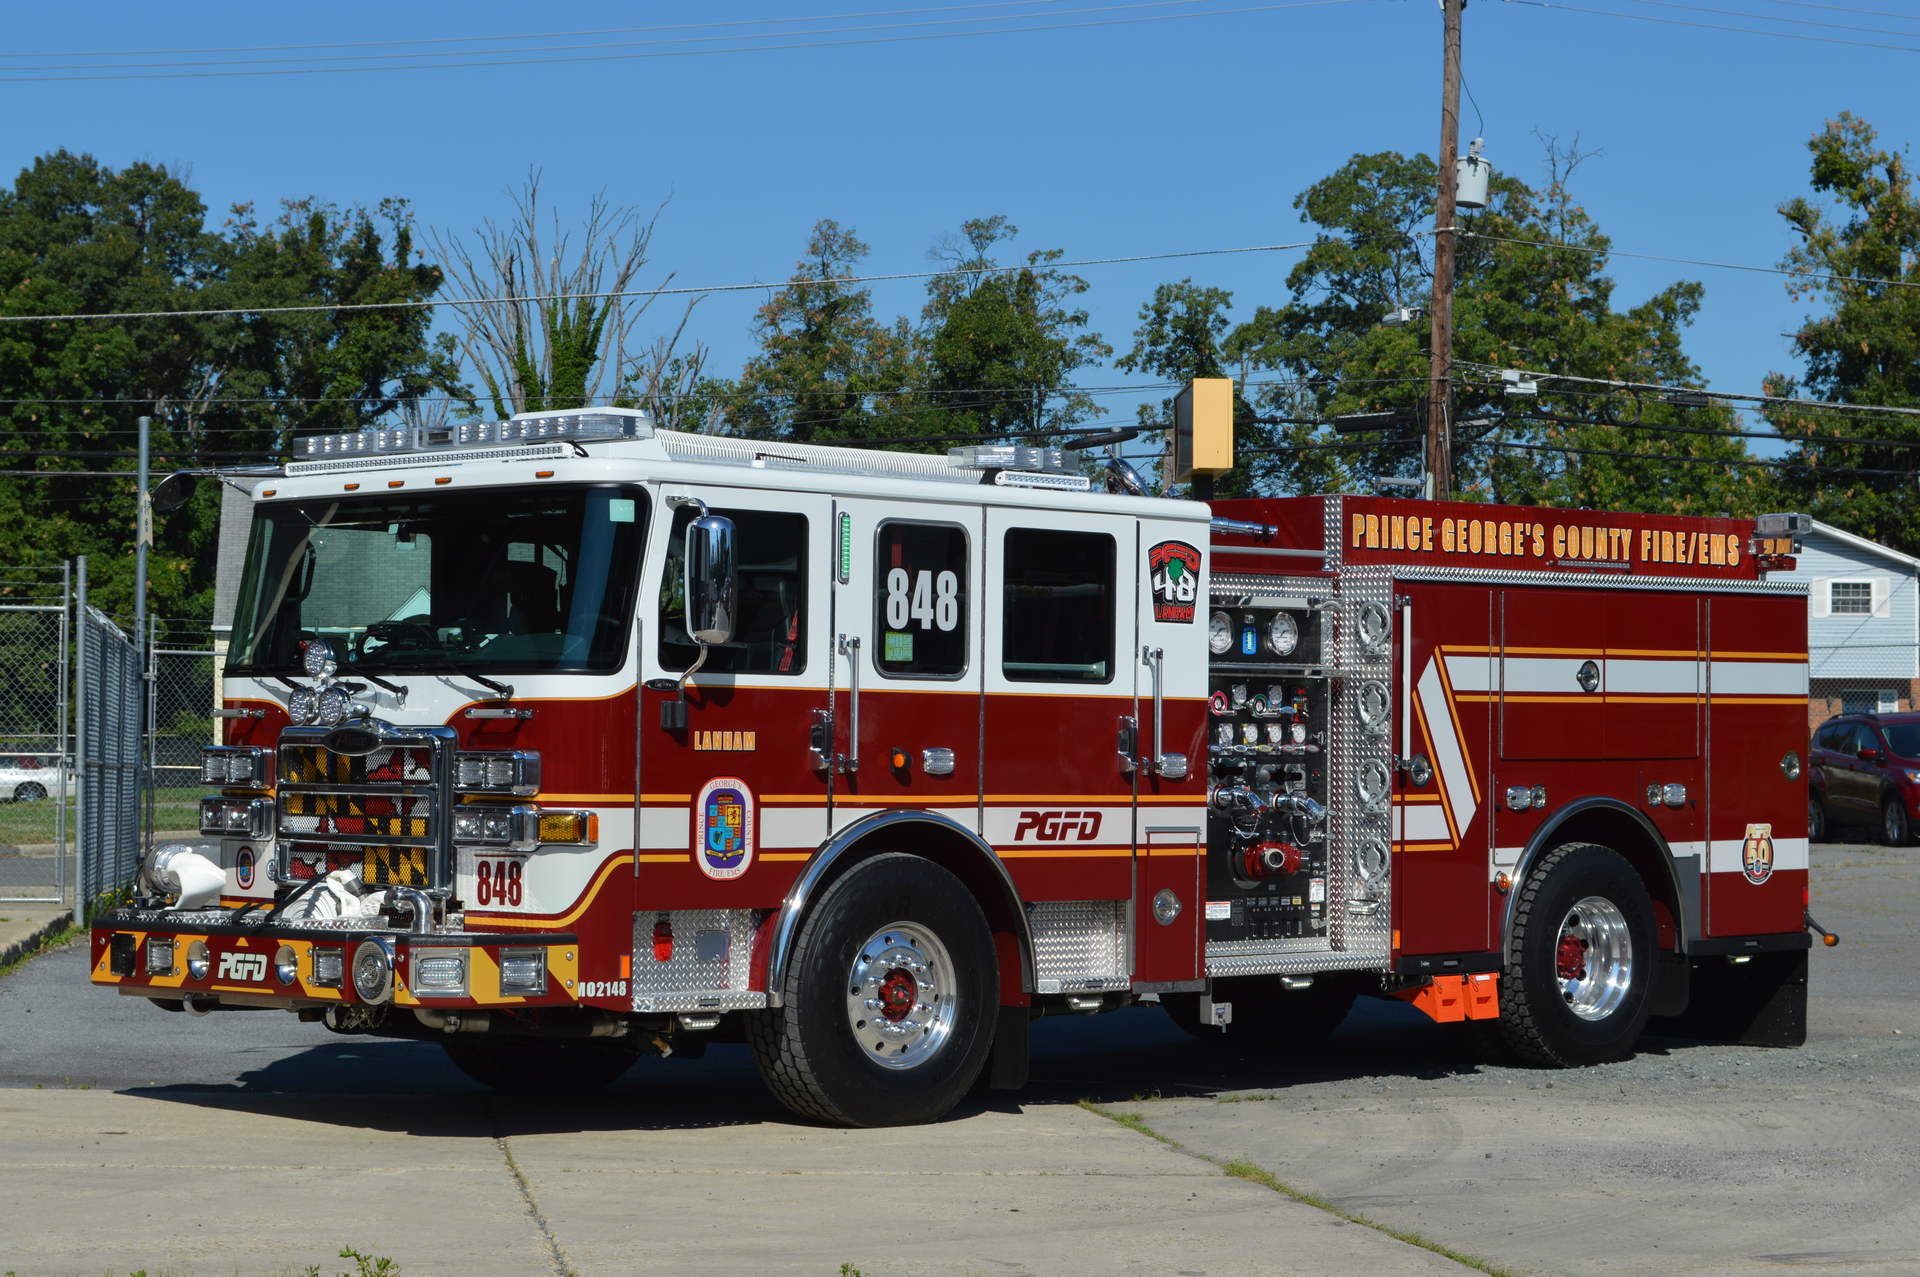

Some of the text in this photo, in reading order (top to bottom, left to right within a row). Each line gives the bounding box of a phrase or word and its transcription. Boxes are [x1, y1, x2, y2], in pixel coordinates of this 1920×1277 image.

[1352, 513, 1740, 566] PRINCE GEORGE'S COUNTY FIRE/EMS
[1150, 543, 1199, 572] PGFD
[1153, 566, 1196, 601] 48
[886, 567, 958, 631] 848
[1155, 604, 1194, 621] LANHAM
[335, 732, 368, 749] Pierce
[694, 730, 756, 751] LANHAM
[709, 779, 742, 790] GEORGE'S
[1014, 811, 1102, 841] PGFD
[1747, 839, 1770, 863] 50
[477, 860, 522, 907] 848
[708, 867, 741, 878] FIRE/EMS
[217, 951, 268, 982] PGFD
